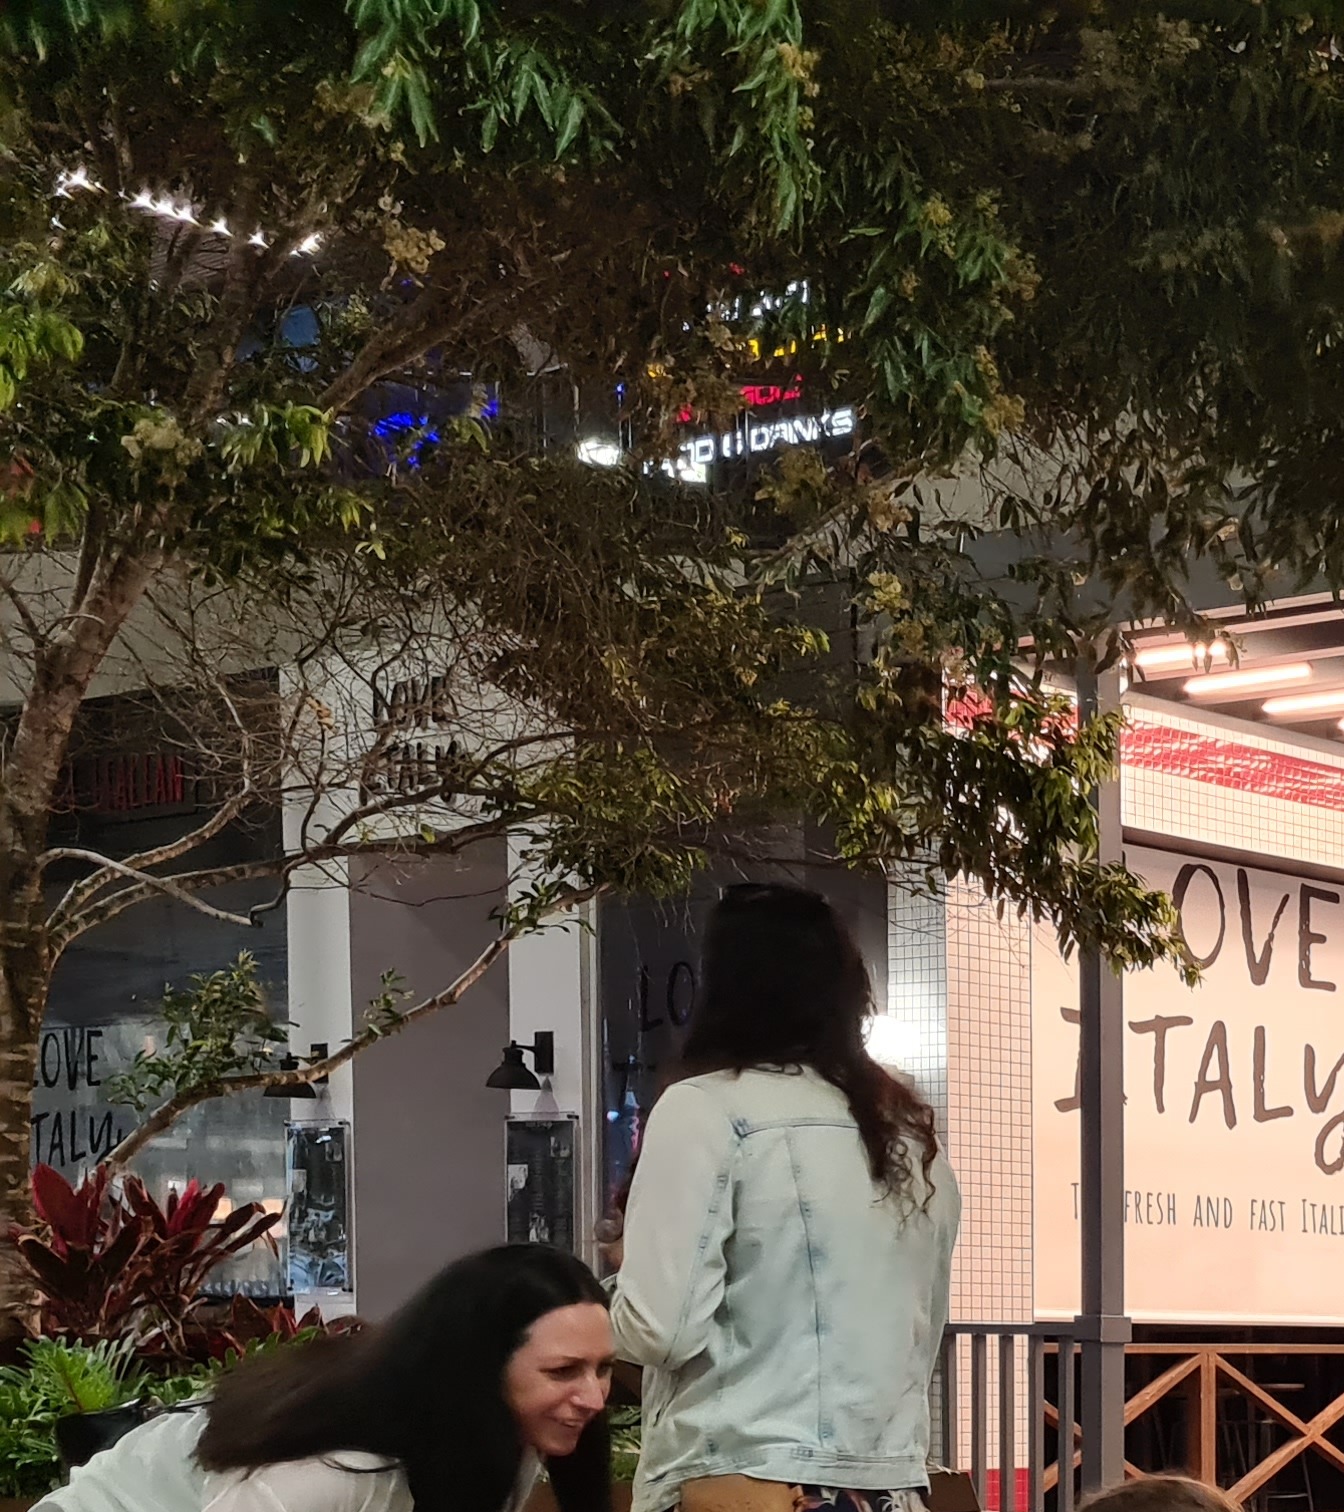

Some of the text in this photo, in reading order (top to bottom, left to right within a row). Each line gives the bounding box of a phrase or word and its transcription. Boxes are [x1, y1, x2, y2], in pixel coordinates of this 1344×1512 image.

[1172, 863, 1340, 992] OVE
[34, 1030, 103, 1091] OVE
[30, 1110, 114, 1167] TALy
[1123, 1189, 1177, 1226] FRESH
[1192, 1194, 1233, 1230] AND
[1249, 1198, 1286, 1232] FAST
